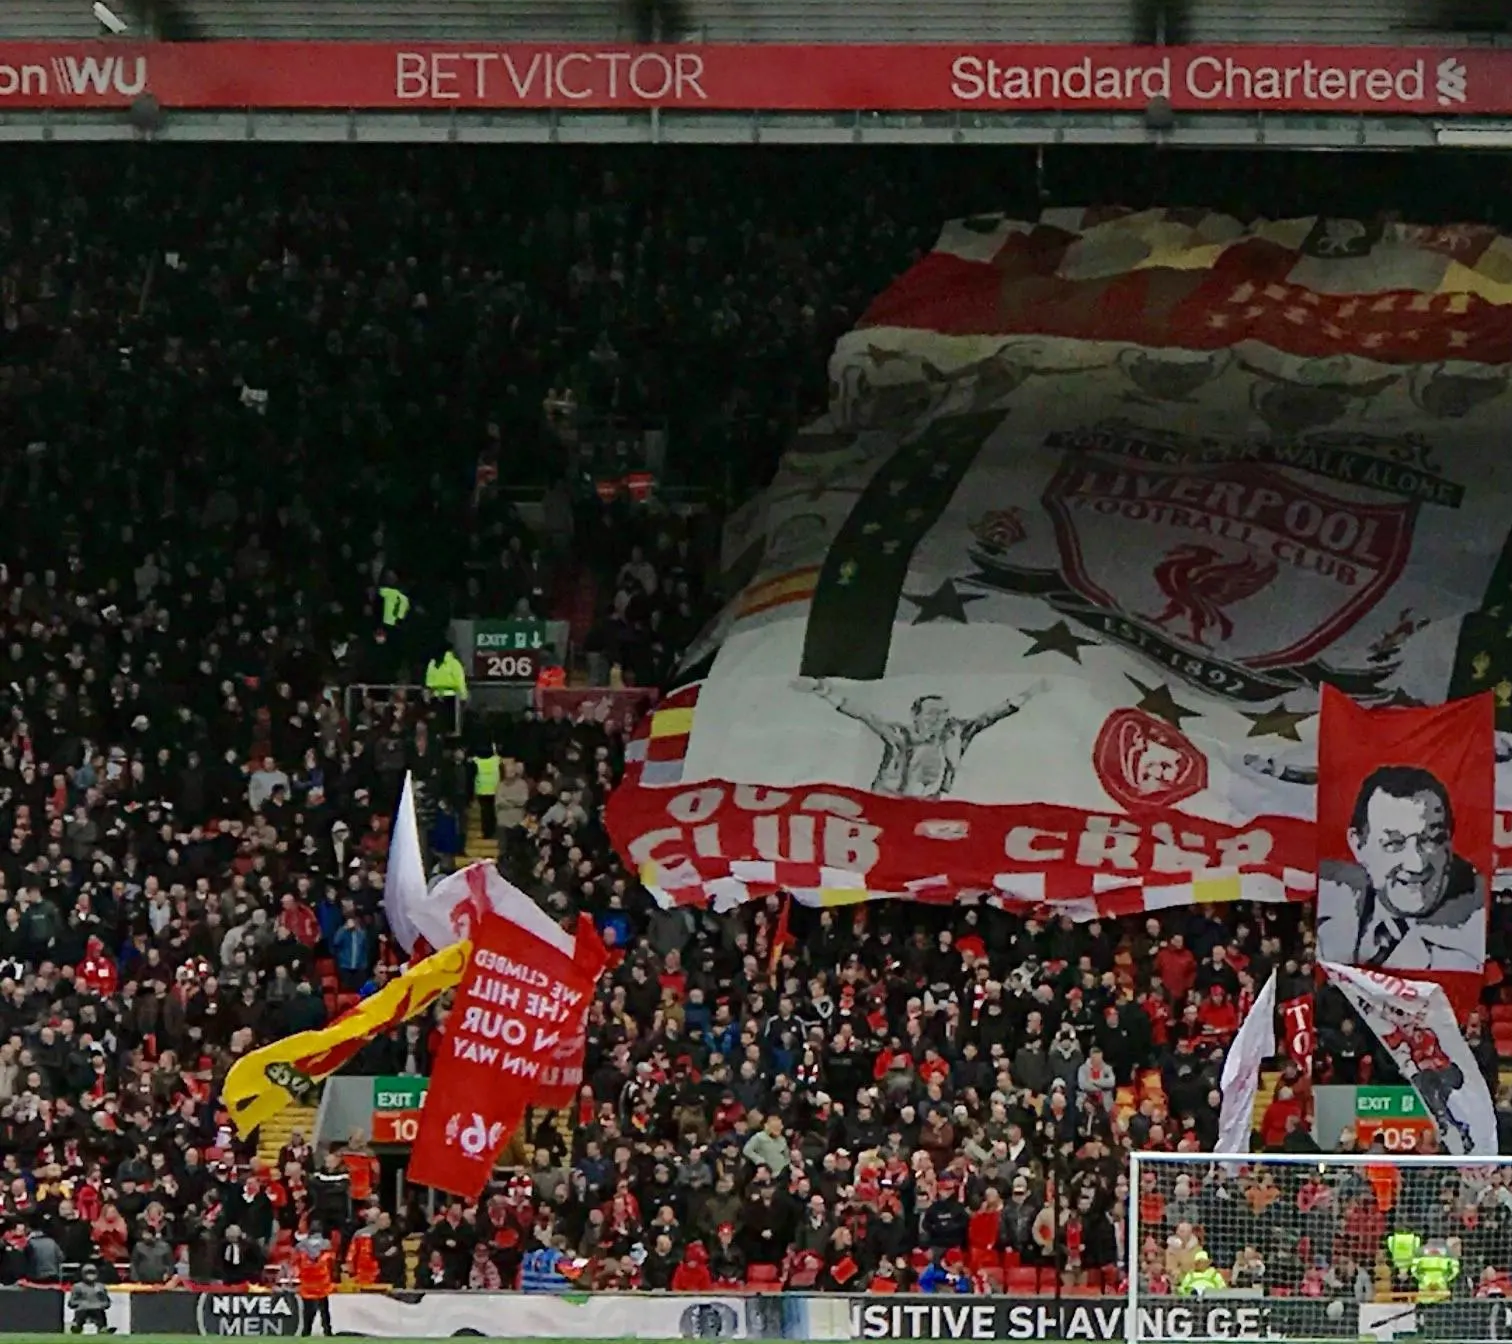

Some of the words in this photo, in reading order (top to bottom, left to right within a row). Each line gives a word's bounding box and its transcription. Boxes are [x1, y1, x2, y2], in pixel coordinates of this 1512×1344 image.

[52, 56, 146, 96] WU
[395, 52, 707, 100] BETVICTOR
[951, 56, 1171, 100] Standard
[1185, 56, 1424, 101] Chartered
[1079, 470, 1383, 564] LIVERPOOL
[476, 632, 509, 647] EXIT
[487, 656, 533, 677] 206
[377, 1092, 414, 1107] EXIT
[1357, 1096, 1392, 1111] EXIT
[390, 1118, 420, 1142] 10
[212, 1296, 293, 1316] NIVEA
[219, 1316, 284, 1336] MEN
